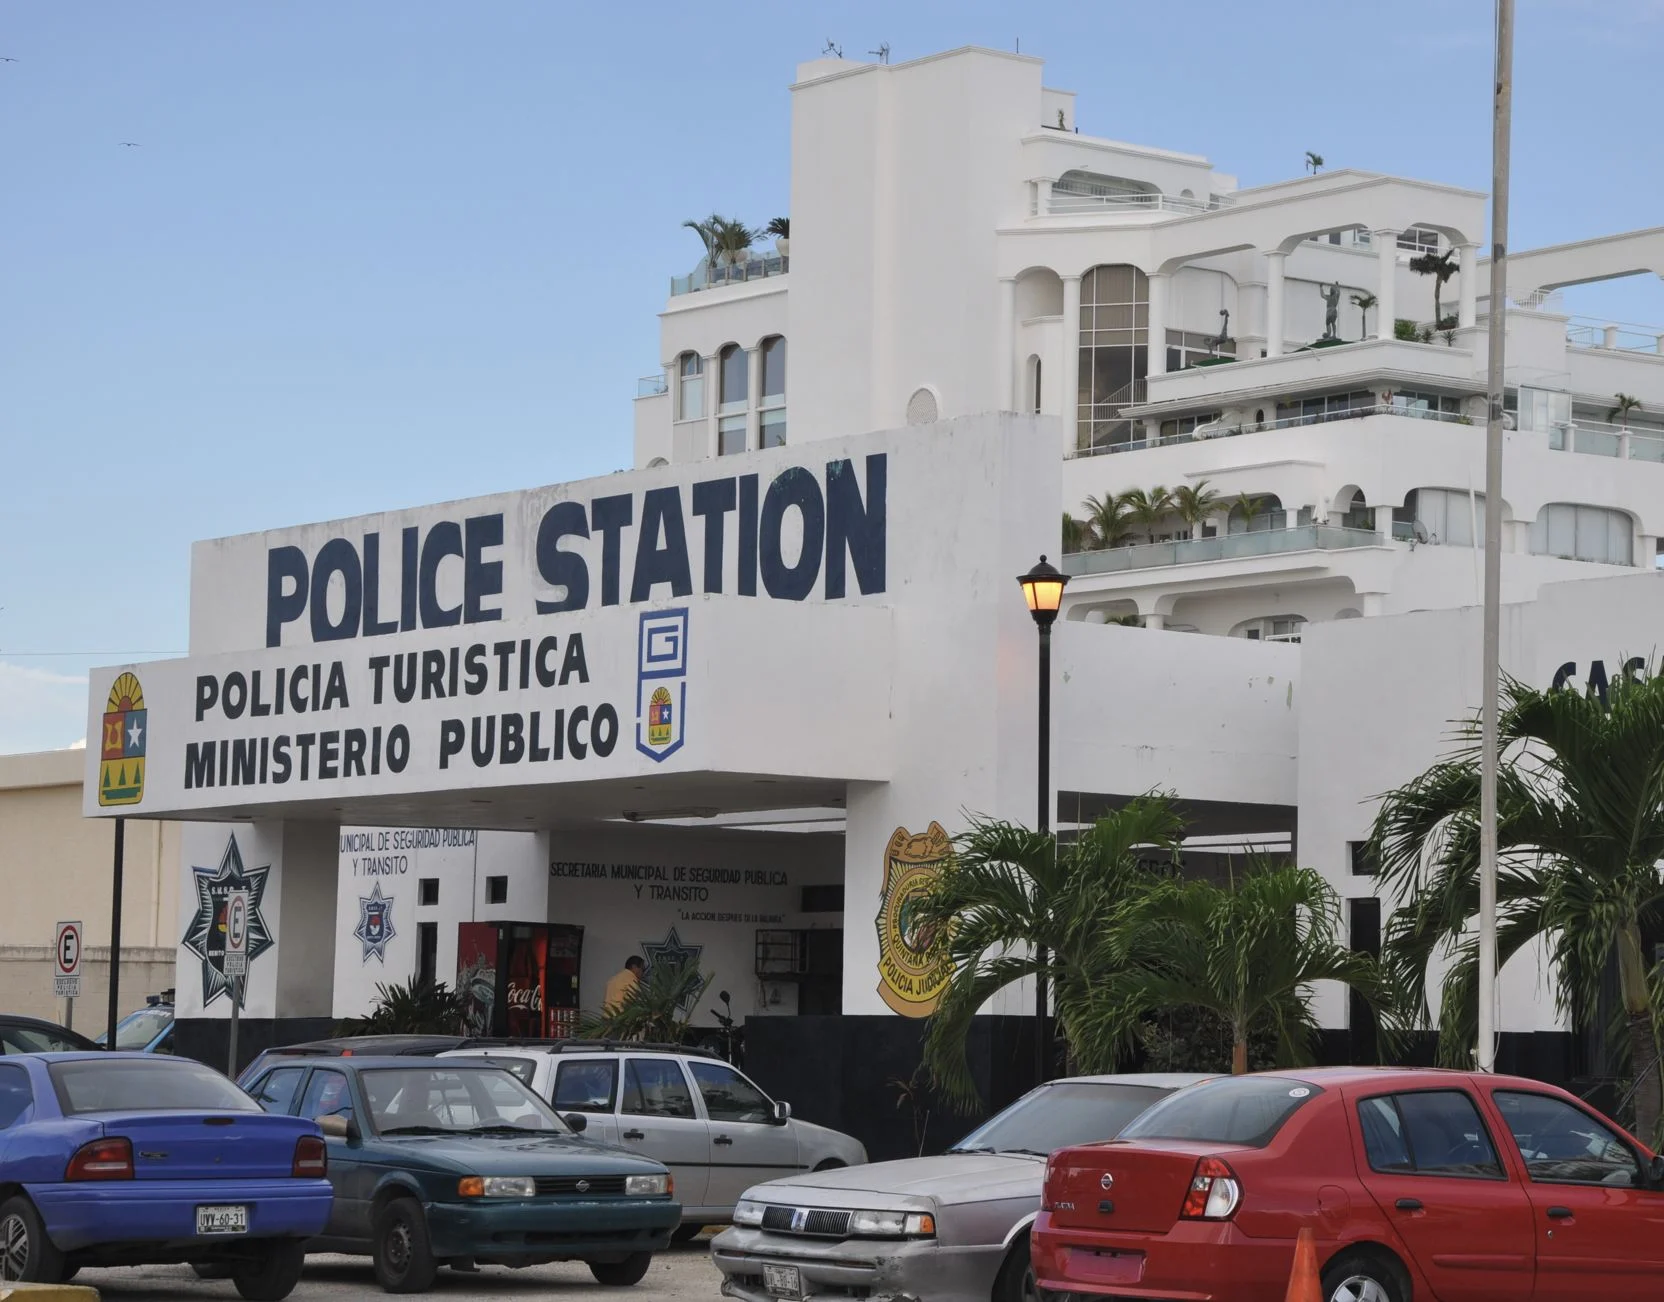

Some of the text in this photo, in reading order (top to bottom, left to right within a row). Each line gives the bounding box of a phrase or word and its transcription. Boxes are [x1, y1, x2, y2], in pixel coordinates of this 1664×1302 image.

[267, 453, 886, 648] POLICE STATION
[196, 633, 589, 721] POLICIA TURISTICA
[185, 703, 618, 789] MINISTERIO PUBLICO
[378, 831, 390, 851] DE
[393, 829, 440, 850] SEGURIDAD
[442, 829, 475, 848] PUBLICA
[352, 855, 408, 876] Y TRANSITO
[550, 862, 788, 886] SECRETARIA MUNICIPAL DE SEGURIDAD PUBLICA
[634, 884, 709, 902] Y TRANSITO
[232, 906, 242, 938] E
[63, 934, 74, 964] E
[893, 934, 924, 966] QUINTANA
[883, 957, 913, 995] POLICIA
